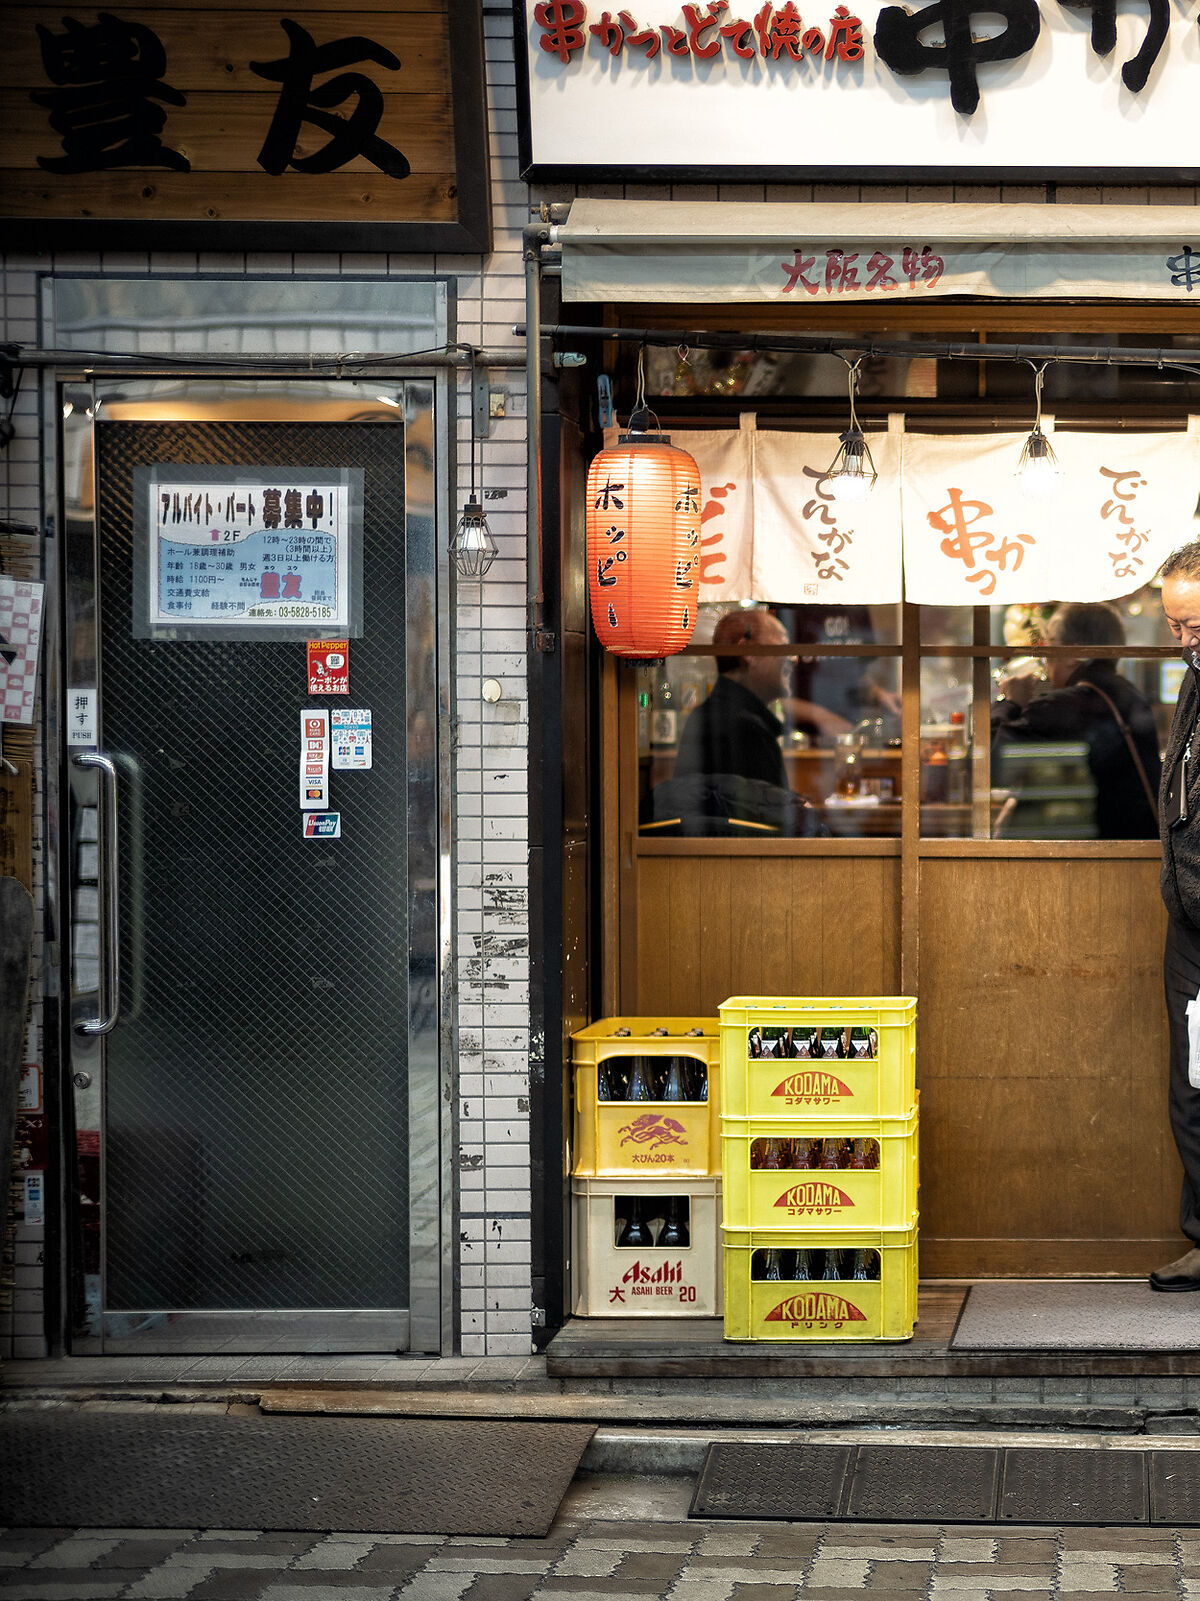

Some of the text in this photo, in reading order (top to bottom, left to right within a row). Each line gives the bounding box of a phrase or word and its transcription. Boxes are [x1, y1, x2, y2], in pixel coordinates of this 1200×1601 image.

[533, 0, 865, 63] 串かつとどて焼の店
[30, 13, 411, 179] 豊友
[781, 246, 945, 296] 大阪名物
[1100, 465, 1149, 577] でんがな
[595, 473, 627, 627] ホッピー
[926, 487, 1036, 596] 串かつ
[75, 696, 88, 725] 押す
[72, 731, 92, 740] PUSH
[784, 1075, 840, 1096] KODAMA
[785, 1097, 840, 1105] コダマサワー
[786, 1185, 842, 1207] KODAMA
[787, 1207, 842, 1216] コダマサワー
[622, 1260, 683, 1284] Asahi
[609, 1286, 626, 1303] 大
[631, 1286, 673, 1296] ASAHI BEER
[679, 1286, 696, 1303] 20
[782, 1299, 850, 1322] KODAMA
[791, 1321, 843, 1329] ドリンク
